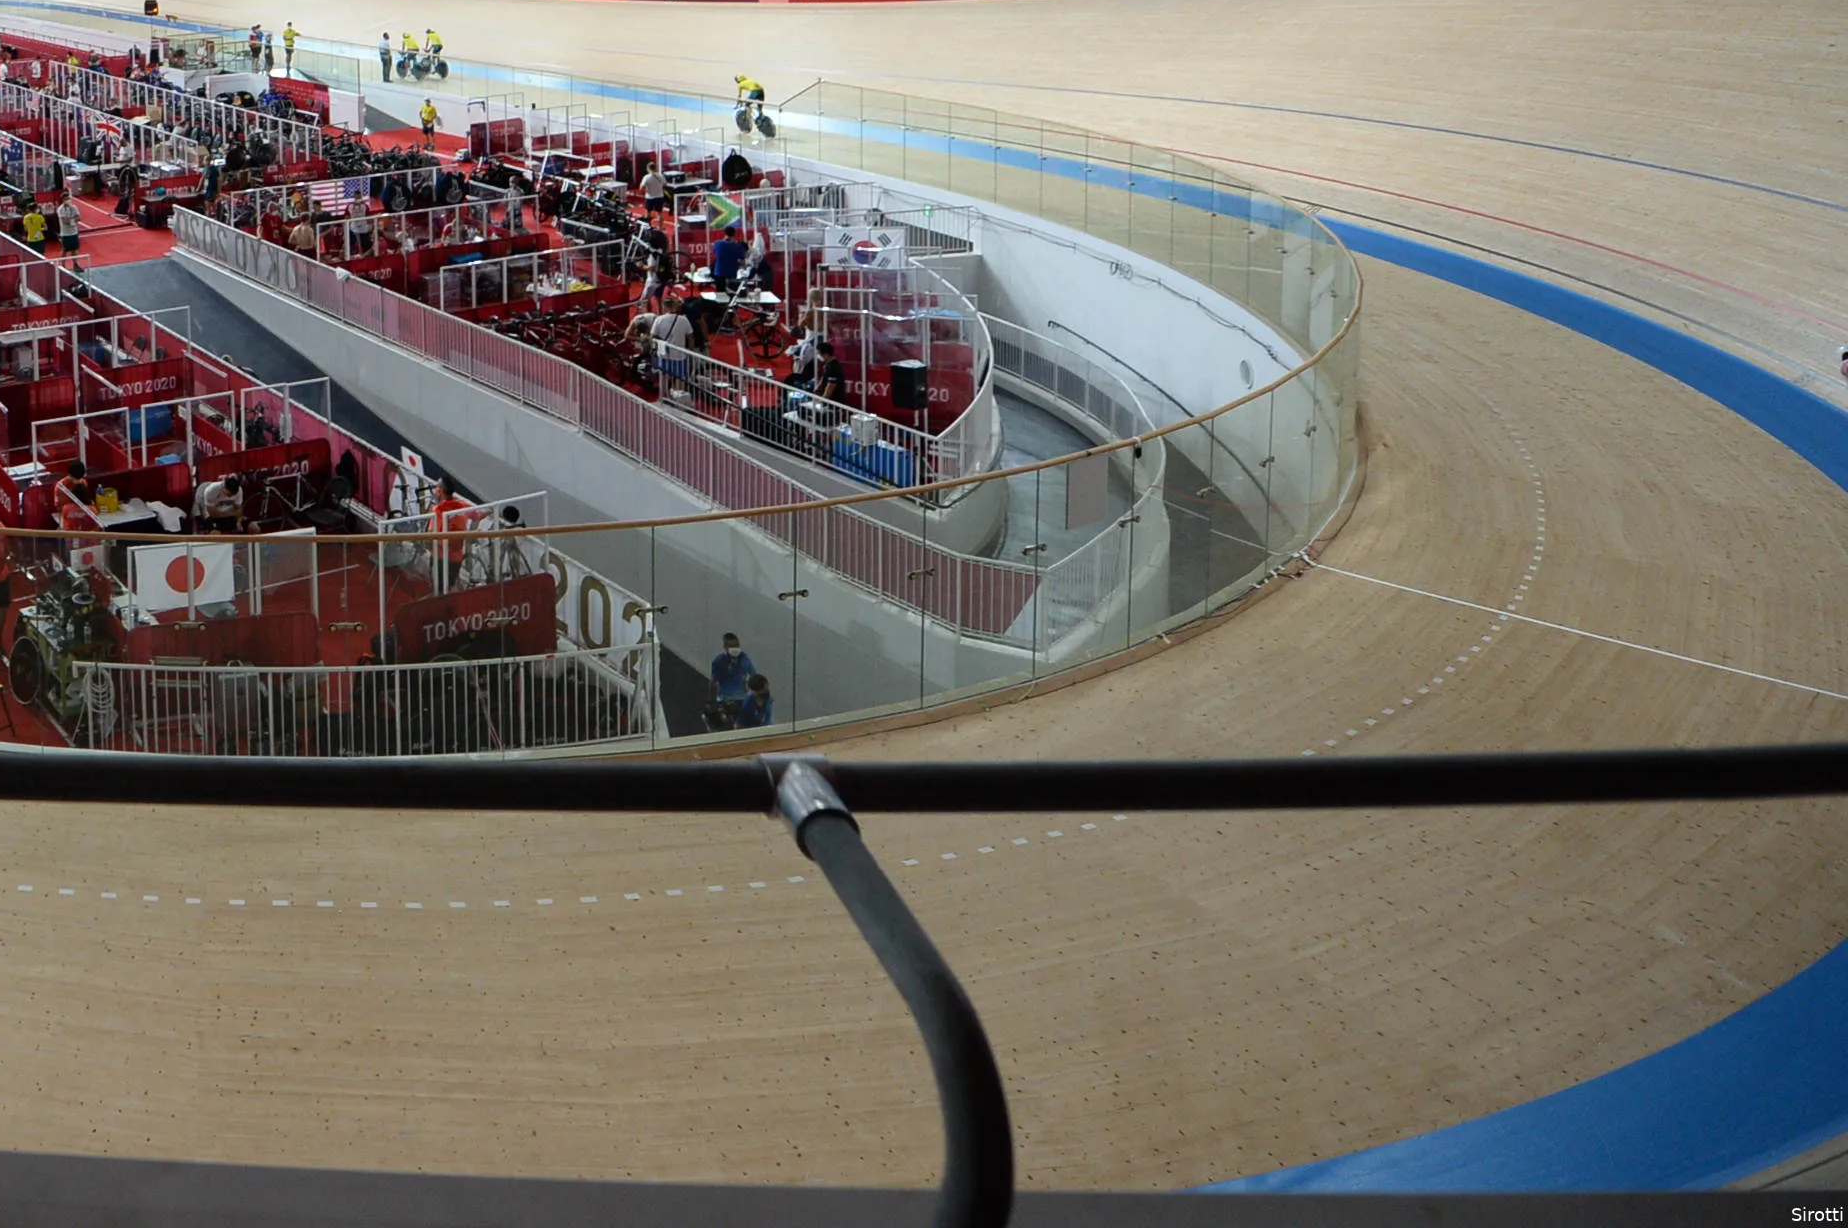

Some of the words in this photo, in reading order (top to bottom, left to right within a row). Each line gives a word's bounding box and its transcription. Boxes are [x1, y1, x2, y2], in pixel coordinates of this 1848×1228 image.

[145, 376, 177, 393] 2020
[845, 380, 890, 397] TOKY
[423, 613, 483, 643] TOKYO
[486, 602, 531, 627] 2020
